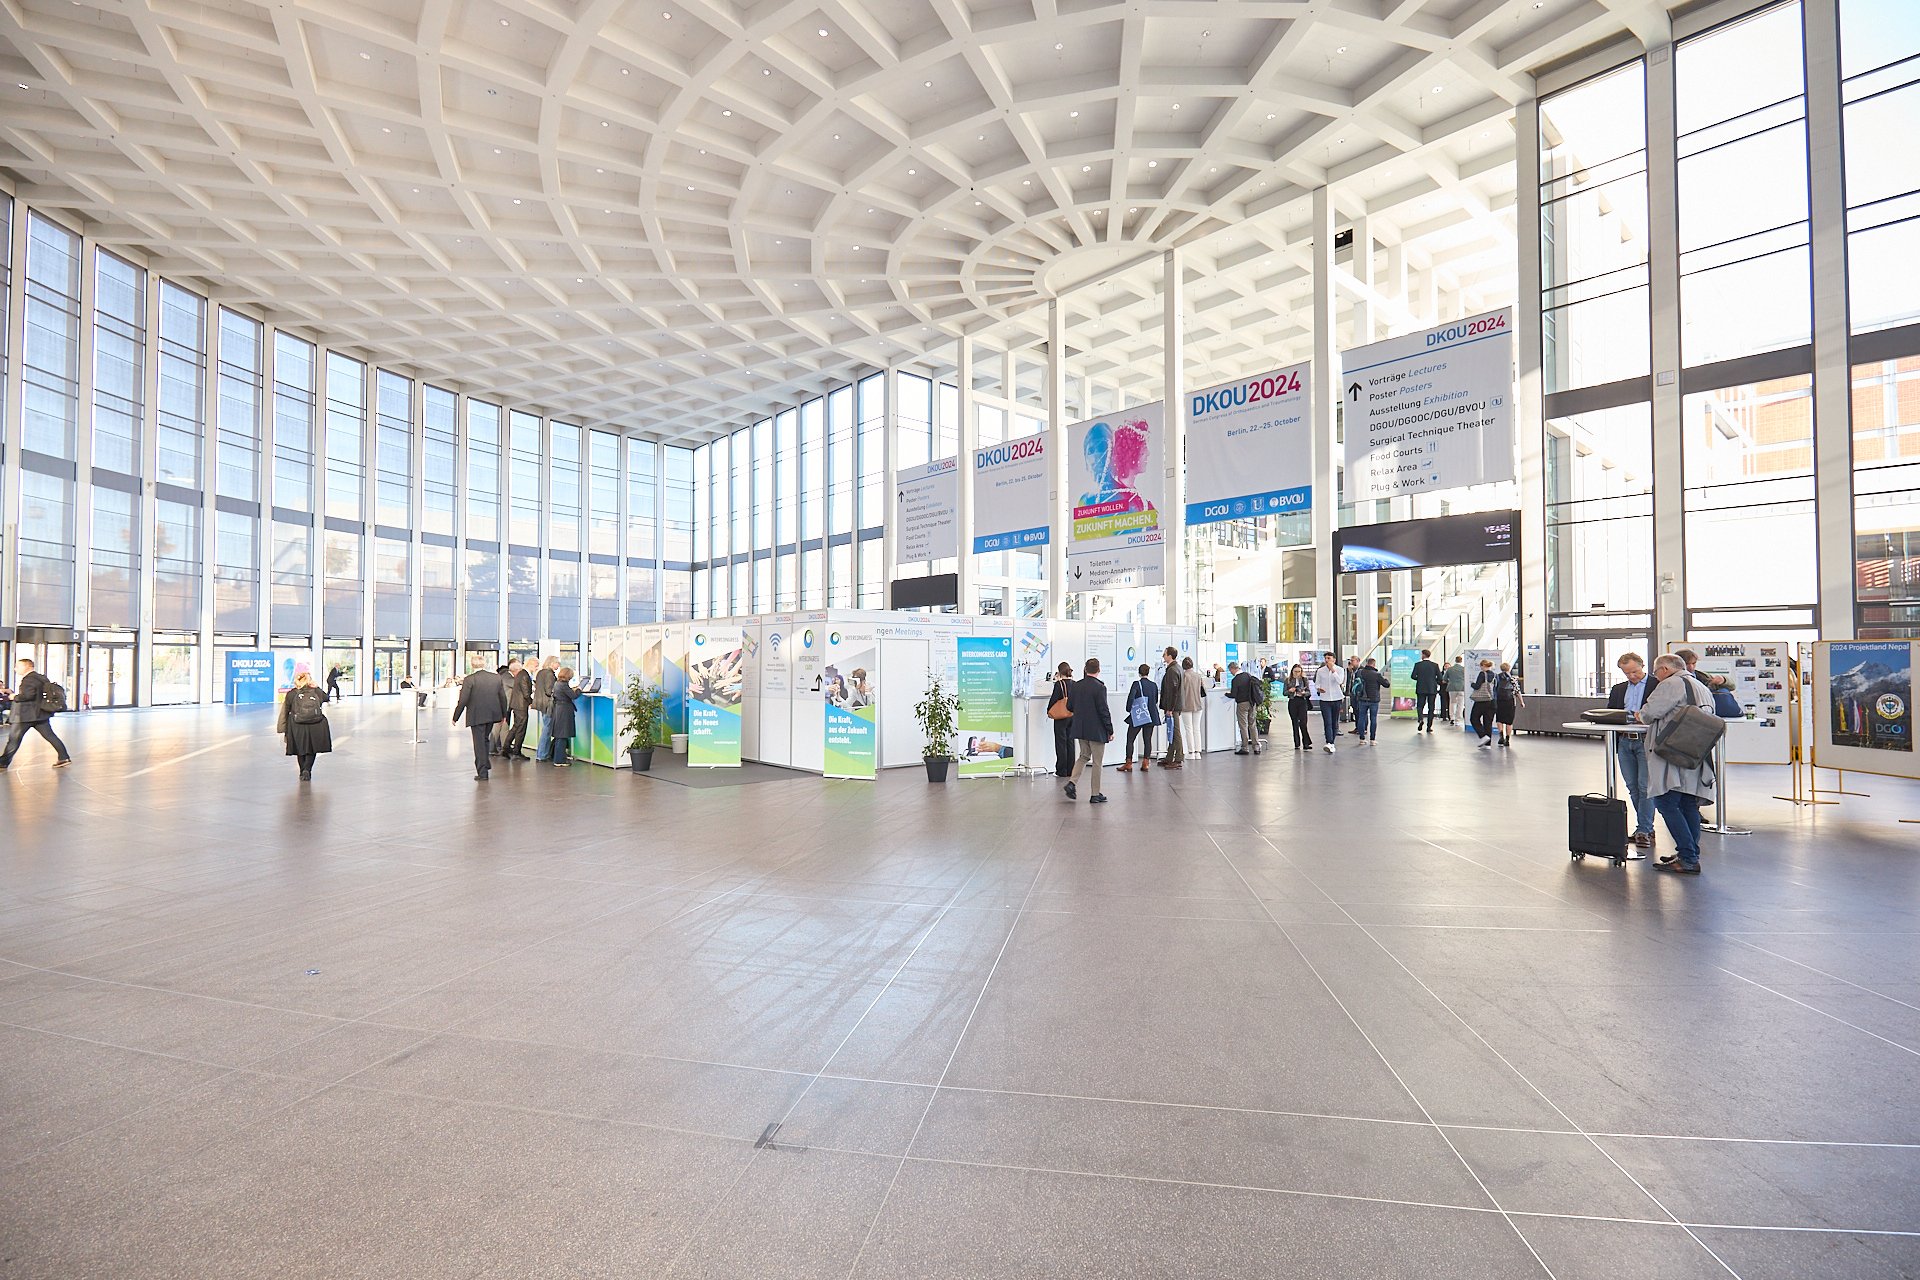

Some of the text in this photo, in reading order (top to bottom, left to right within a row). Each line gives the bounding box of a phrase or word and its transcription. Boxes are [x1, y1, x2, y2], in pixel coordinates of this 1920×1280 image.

[1426, 314, 1506, 346] DKOU2024
[1368, 362, 1447, 386] Vorträge Lectures
[1193, 370, 1301, 416] DKOU2024
[1369, 382, 1432, 402] Poster Posters
[1369, 390, 1469, 417] Ausstellung Exhibition
[1227, 427, 1248, 437] Berlin,
[1275, 416, 1301, 426] October
[1370, 401, 1486, 432] DGOU/DGOOC/DGU/BVOU
[1370, 417, 1496, 447] Surgical Technique Theater
[978, 438, 1043, 469] DKOU2024
[1370, 446, 1423, 462] Food Courts
[927, 460, 955, 474] DKOU2024
[1370, 463, 1418, 477] Relax Area
[1371, 482, 1390, 492] Plug
[1402, 477, 1425, 487] Work
[1078, 503, 1124, 517] ZUKUNFT WOLLEN.
[1076, 514, 1153, 534] ZUKUNFT MACHEN.
[1128, 533, 1162, 544] DKOU2024
[877, 628, 923, 636] ngen Meetings
[1849, 644, 1887, 652] Projektland
[232, 659, 253, 668] DKOU
